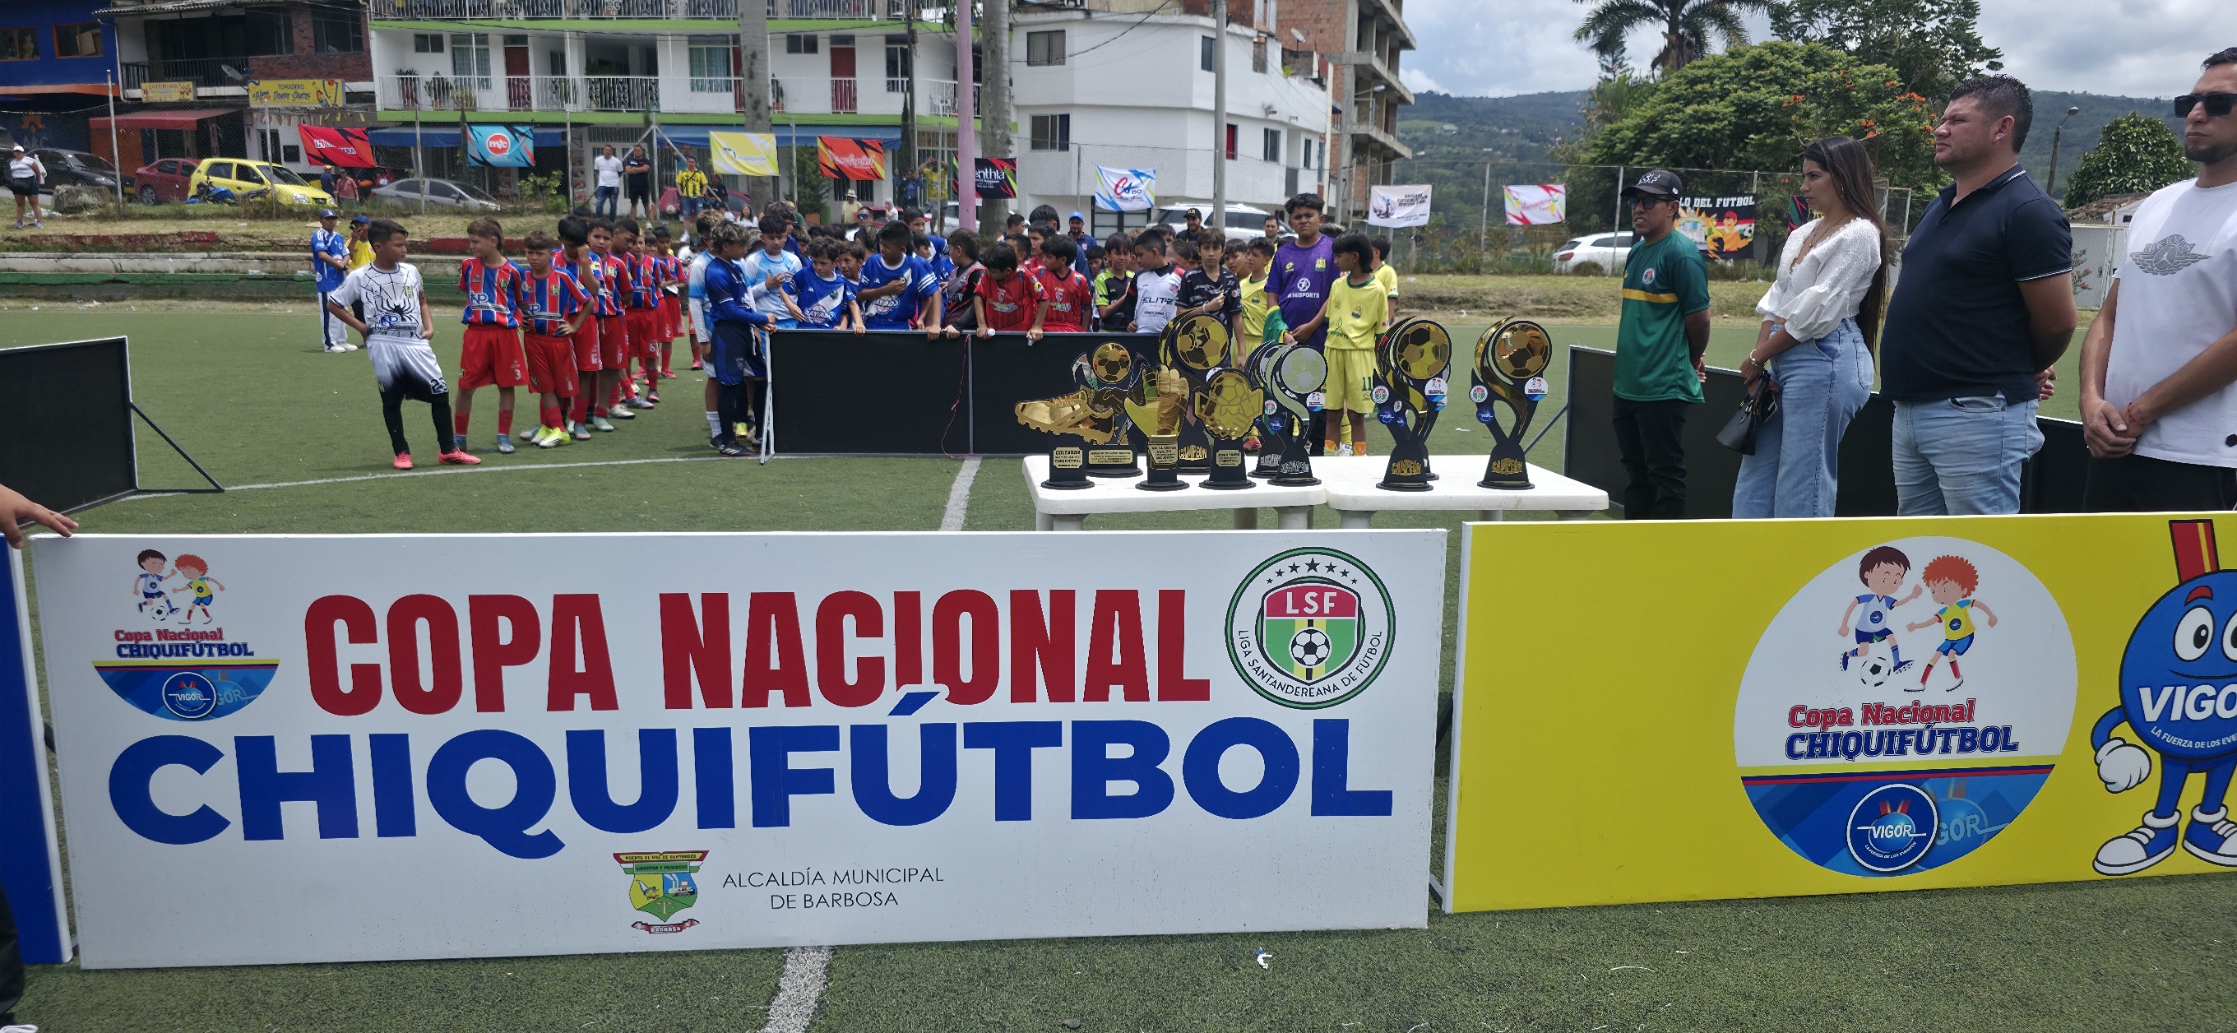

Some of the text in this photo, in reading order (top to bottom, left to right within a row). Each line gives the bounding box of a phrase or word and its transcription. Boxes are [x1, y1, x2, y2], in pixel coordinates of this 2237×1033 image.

[1693, 196, 1713, 208] DEL
[1715, 195, 1755, 208] FUTBOL
[1361, 376, 1373, 391] 11
[1286, 591, 1337, 614] LSF
[115, 627, 224, 645] Copa Nacional
[116, 640, 254, 660] CHIQUIFÚTBOL
[306, 590, 1210, 715] COPA NACIONAL
[1238, 630, 1383, 697] LIGA SANTANDEREANA DE FÚTBOL
[176, 692, 203, 701] VIGOR
[217, 689, 242, 706] GOR
[1788, 698, 1976, 732] Copa Nacional
[1785, 723, 2019, 762] CHIQUIFÚTBOL
[2150, 725, 2237, 749] LA FUERZA DE LOS EVE
[109, 691, 1392, 861] CHIQUIFÚTBOL
[1872, 824, 1912, 839] VIGOR
[1935, 814, 1982, 846] GOR
[722, 867, 944, 888] ALCALDÍA MUNICIPAL
[770, 891, 899, 910] DE BARBOSA
